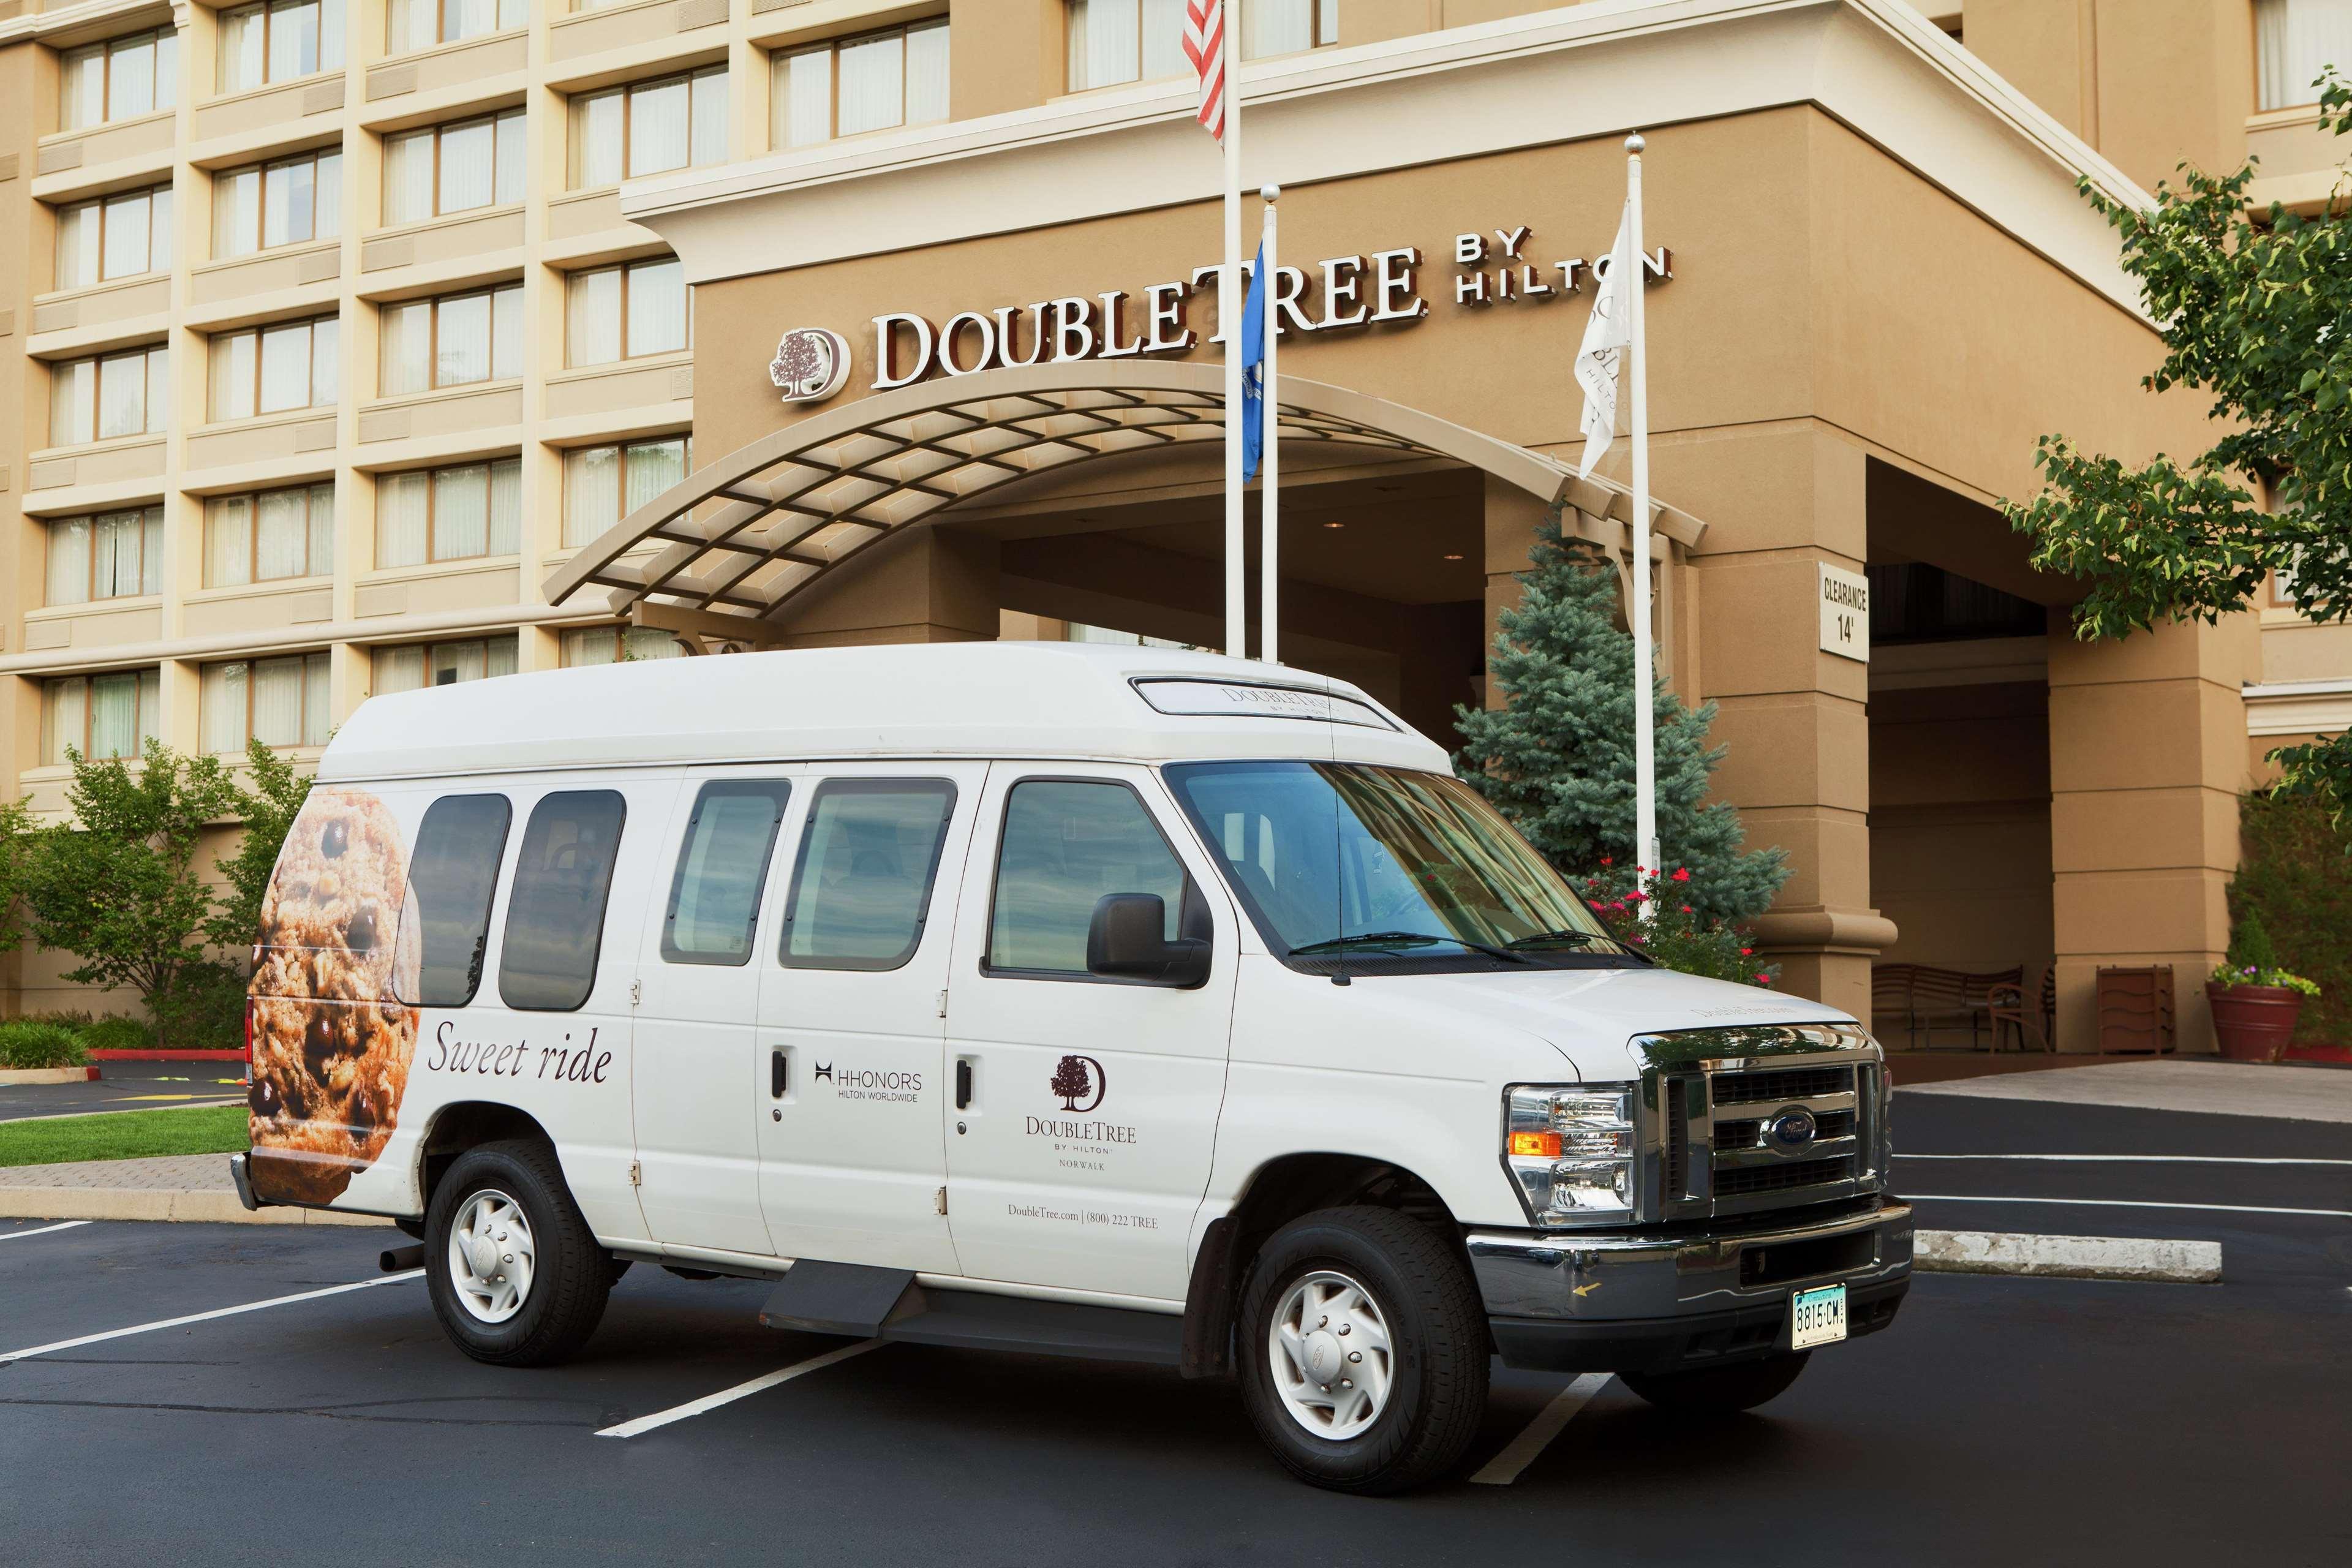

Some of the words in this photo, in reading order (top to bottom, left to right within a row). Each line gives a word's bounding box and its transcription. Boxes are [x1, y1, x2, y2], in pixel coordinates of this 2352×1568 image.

[1455, 227, 1533, 266] BY
[1455, 246, 1673, 307] HILTON
[870, 247, 1428, 391] DOUBLETREE
[1586, 369, 1616, 410] HILTO
[1825, 577, 1866, 612] CLEARANCE
[428, 1021, 529, 1077] Sweet
[538, 1027, 612, 1084] ride
[838, 1069, 922, 1091] HHONORS
[838, 1090, 865, 1099] HILTON
[868, 1091, 918, 1103] WORLDWIDE
[1025, 1116, 1137, 1144] DOUBLETREE
[1059, 1159, 1105, 1171] NORWALK
[1072, 1145, 1109, 1155] HILTON
[1008, 1204, 1079, 1221] DoubleTree.com
[1086, 1211, 1110, 1226] (800)
[1112, 1214, 1128, 1226] 222
[1130, 1215, 1158, 1229] TREE
